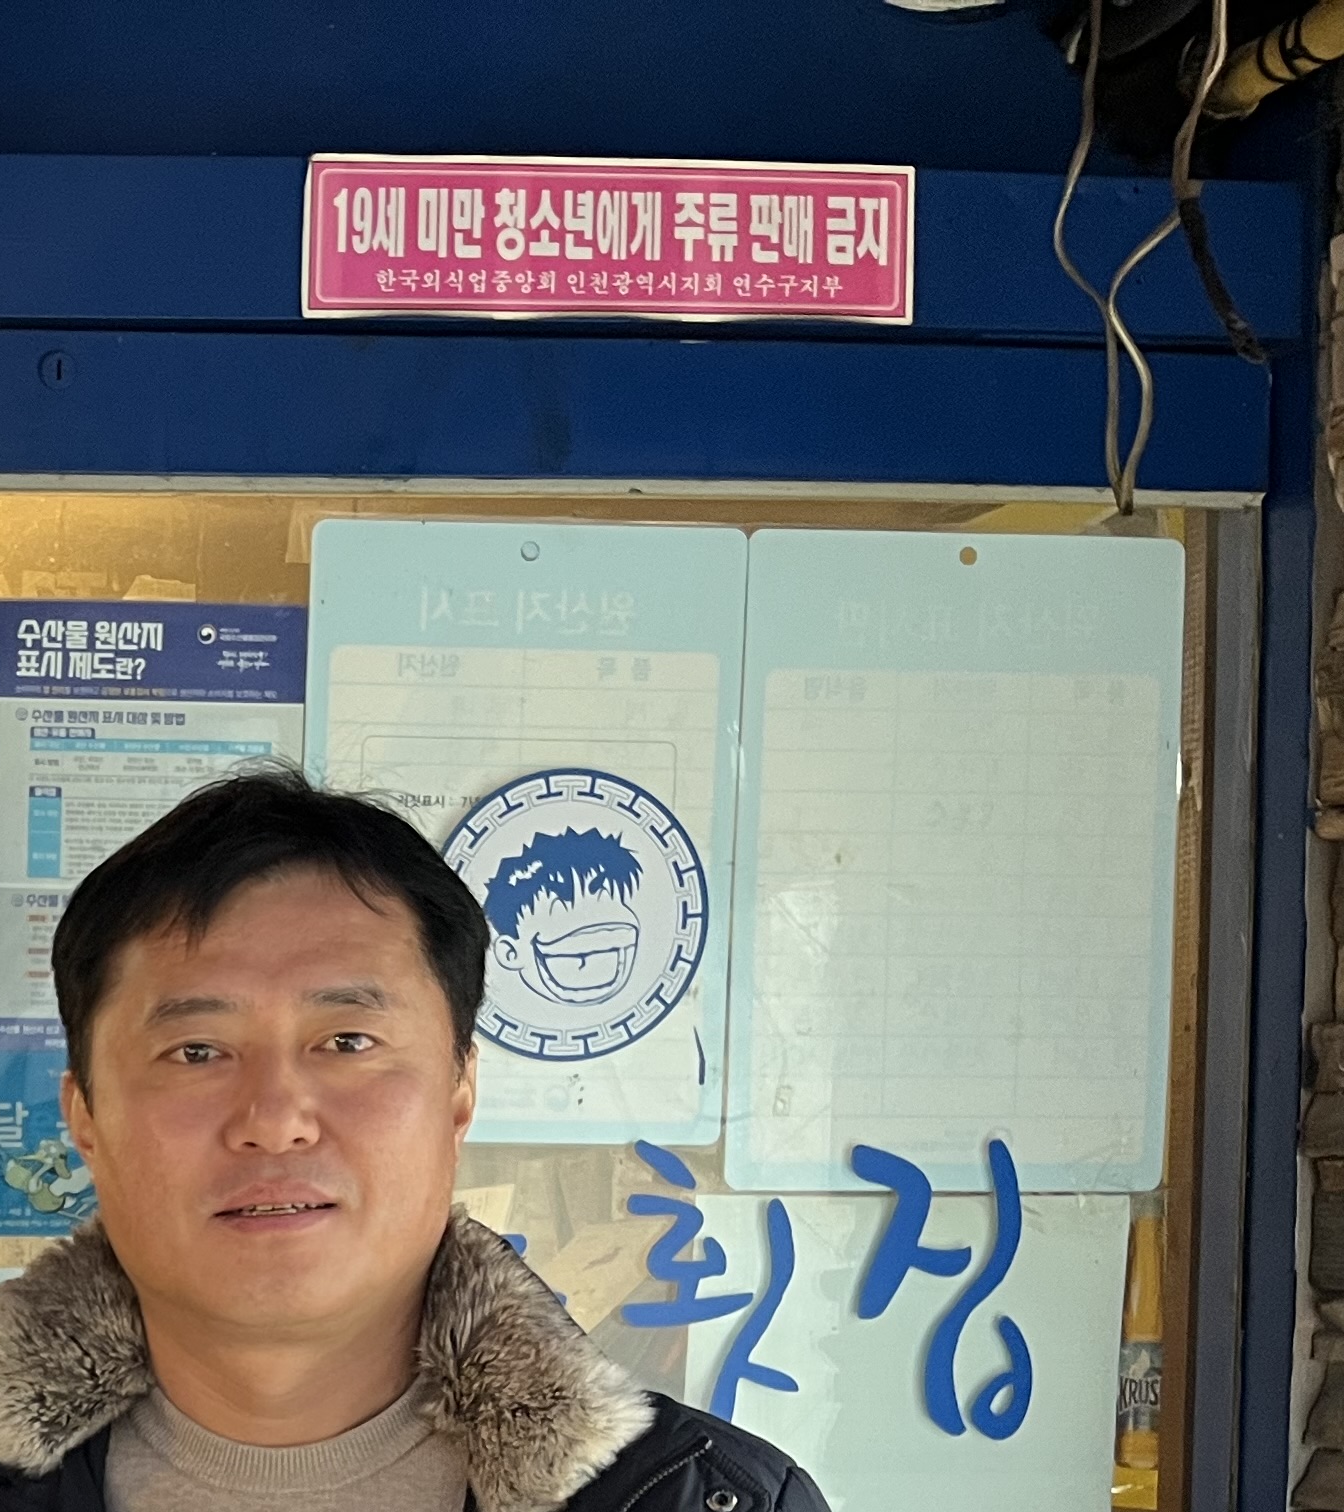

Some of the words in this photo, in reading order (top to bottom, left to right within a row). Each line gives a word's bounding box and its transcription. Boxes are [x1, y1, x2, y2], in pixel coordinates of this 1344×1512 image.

[333, 187, 404, 258] 19세
[418, 187, 485, 257] 미만
[494, 188, 662, 261] 청소년에게
[674, 191, 738, 263] 주류
[749, 193, 813, 264] 판매
[826, 196, 889, 266] 금지
[375, 269, 557, 293] 한국외식업중앙회
[567, 269, 722, 295] 인천광역시지회
[733, 274, 843, 298] 연수구지부
[16, 618, 90, 650] 수산물
[94, 621, 164, 651] 원산지
[16, 650, 62, 679] 표시
[68, 651, 146, 681] 제도란?
[501, 1138, 1033, 1441] 횟집
